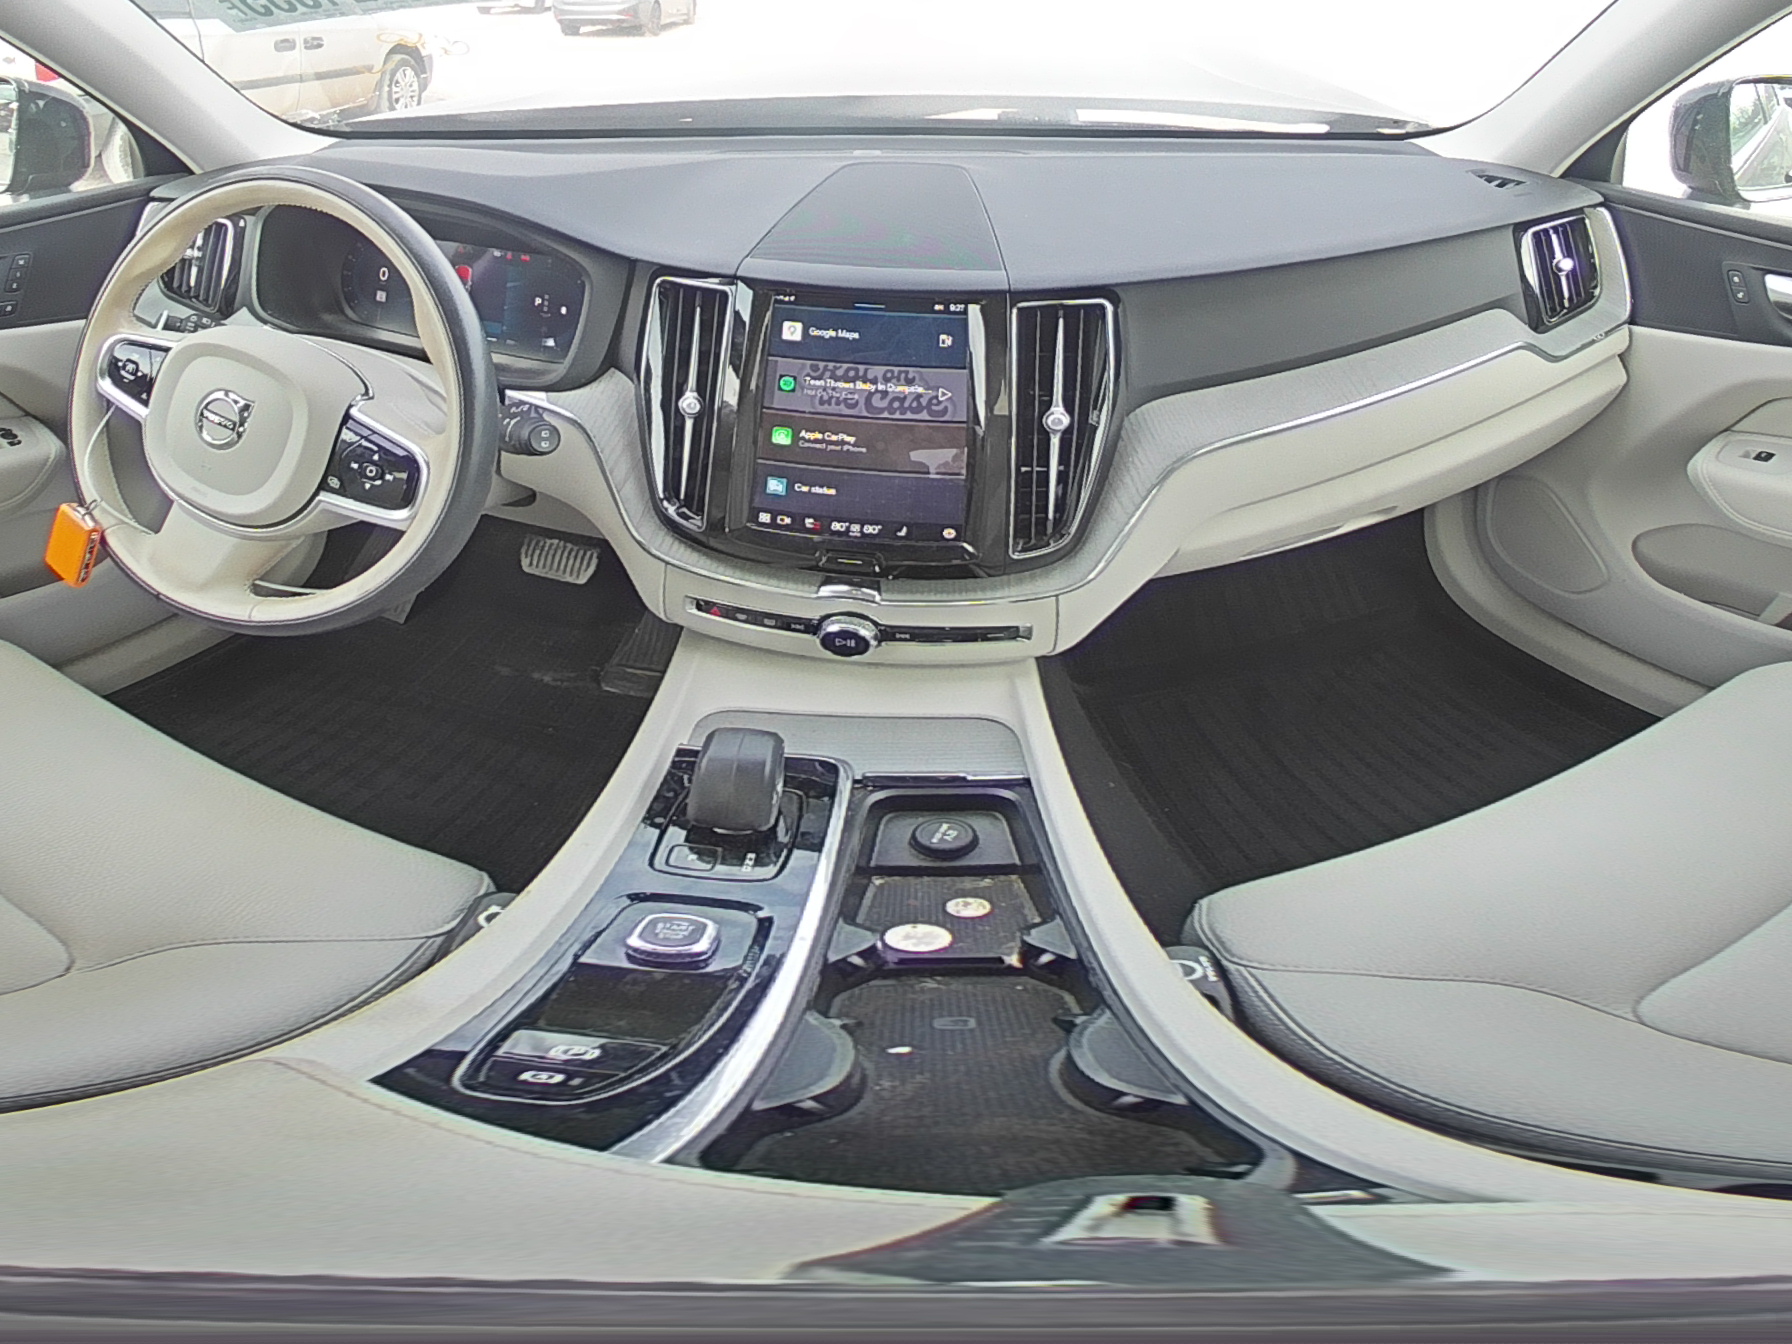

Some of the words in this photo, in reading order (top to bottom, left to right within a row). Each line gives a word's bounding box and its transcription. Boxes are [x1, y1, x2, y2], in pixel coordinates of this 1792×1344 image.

[809, 327, 836, 338] Google
[838, 330, 860, 340] Maps
[804, 376, 825, 387] Teen
[855, 381, 876, 392] Baby
[864, 391, 949, 418] Case
[799, 430, 823, 441] Apple
[824, 432, 856, 444] CarPlay
[799, 440, 826, 450] Connect
[843, 444, 867, 453] iPhone
[794, 483, 809, 493] Car
[811, 485, 836, 495] status
